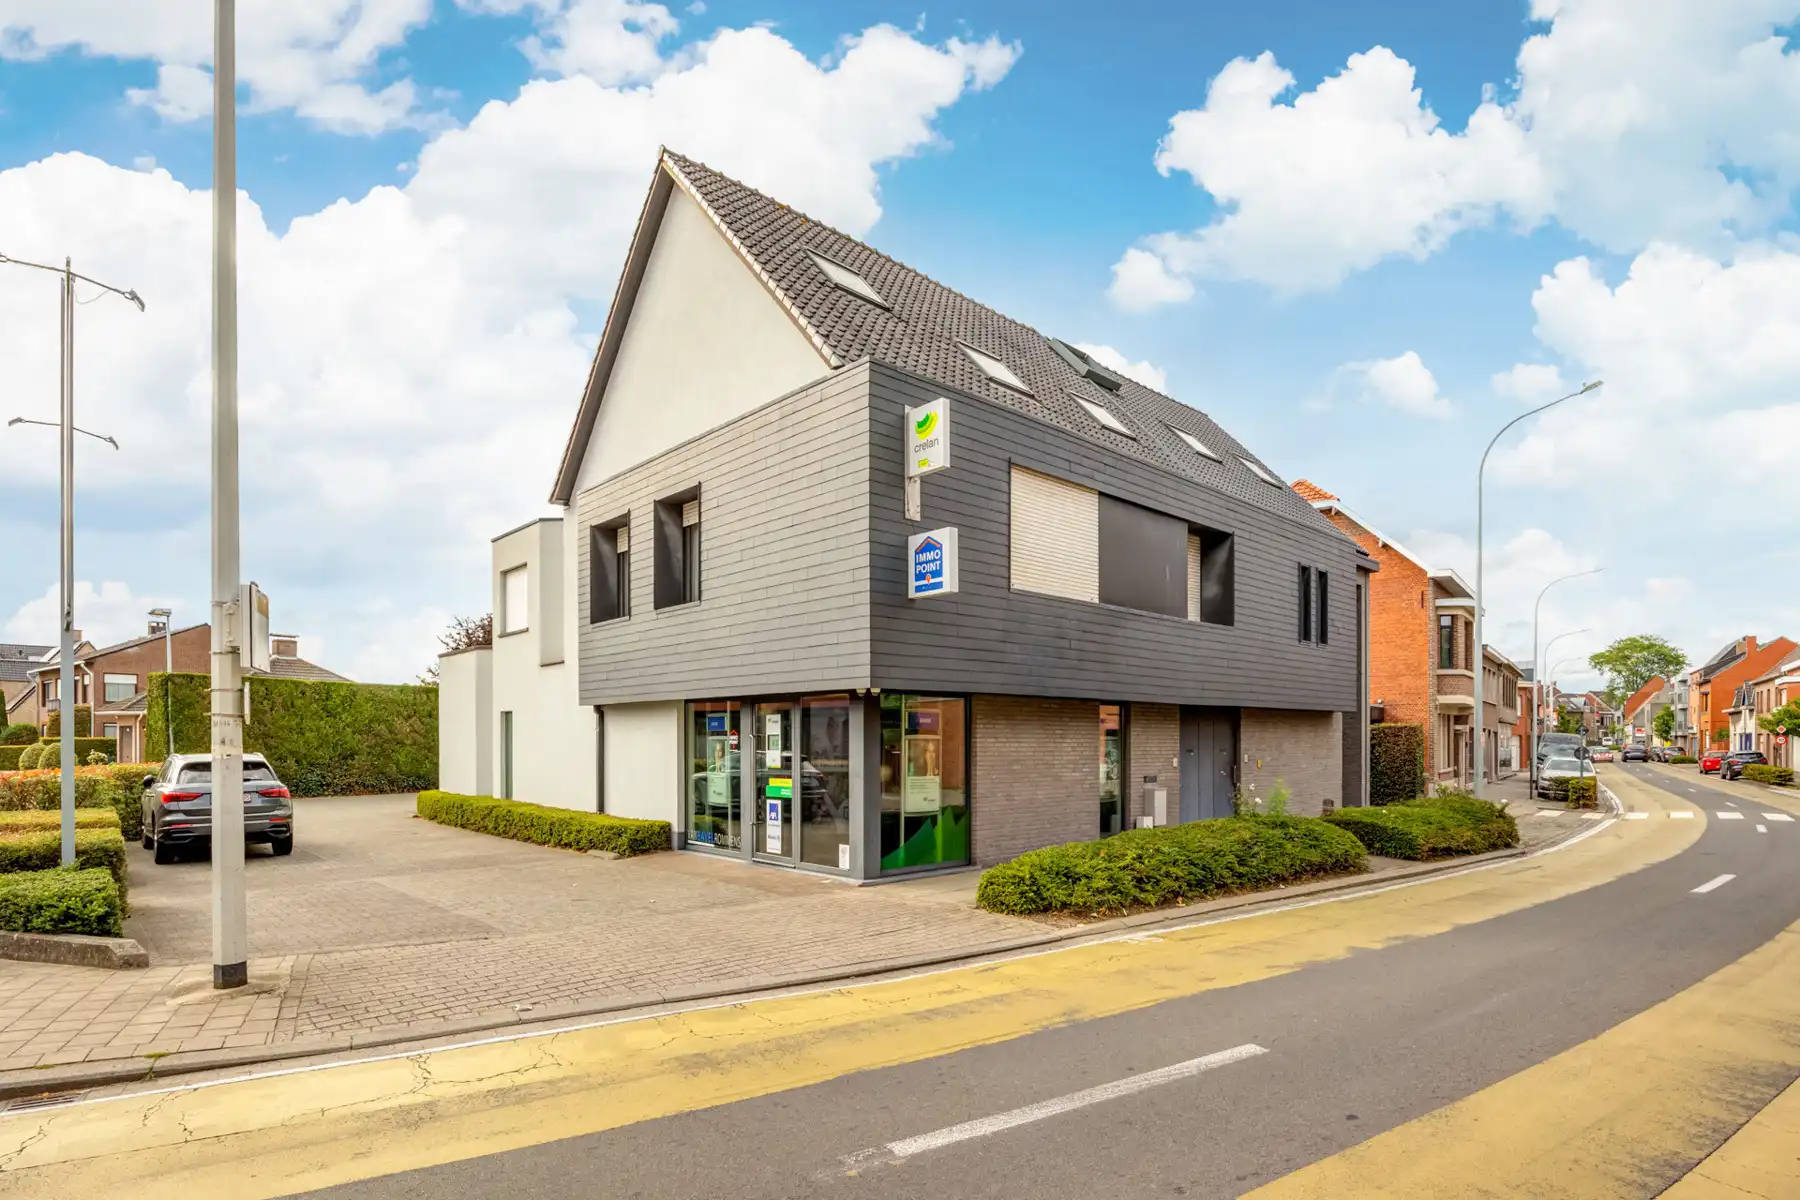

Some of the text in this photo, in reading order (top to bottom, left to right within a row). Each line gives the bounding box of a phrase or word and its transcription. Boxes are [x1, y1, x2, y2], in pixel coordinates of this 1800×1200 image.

[914, 438, 940, 453] crelan
[916, 549, 941, 563] IMMO
[916, 561, 941, 574] POINT
